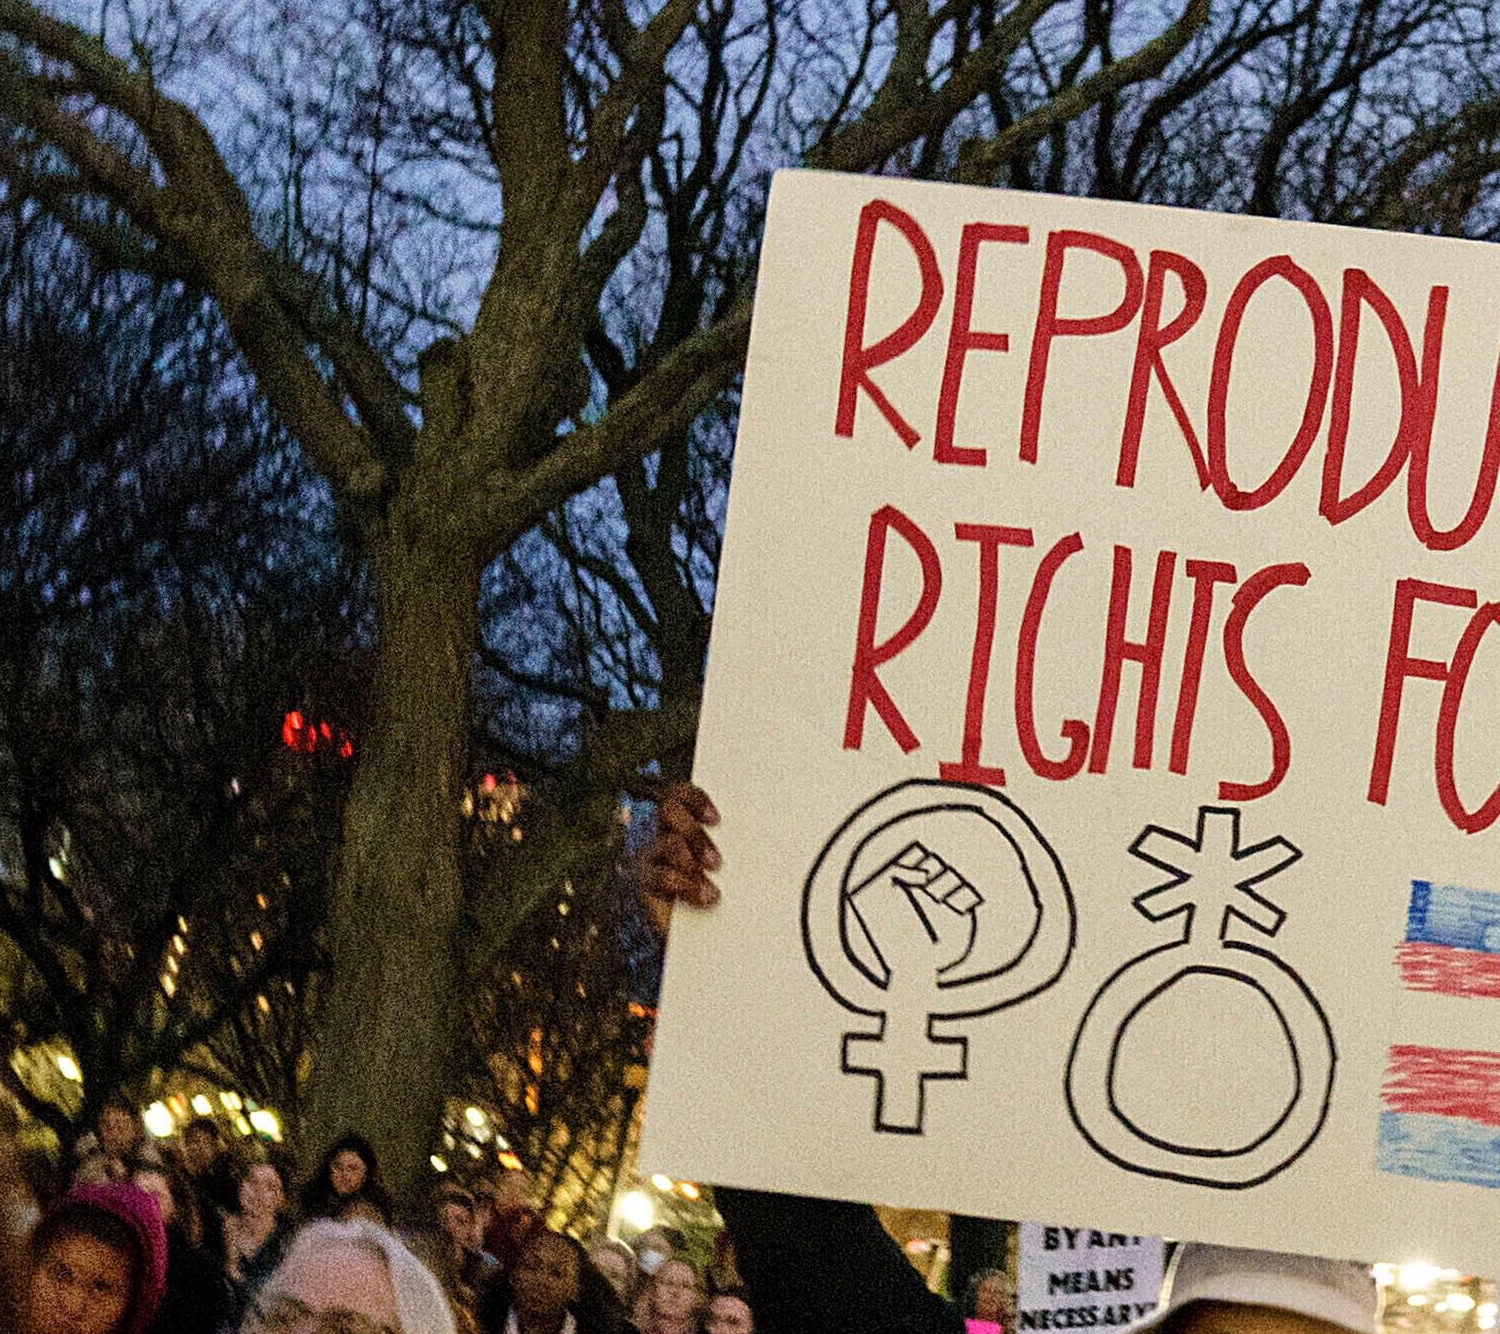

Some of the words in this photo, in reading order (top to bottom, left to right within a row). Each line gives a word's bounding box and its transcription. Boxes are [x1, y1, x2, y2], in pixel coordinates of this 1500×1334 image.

[843, 505, 1311, 801] RIGHTS
[1043, 1226, 1079, 1251] BY
[1049, 1267, 1135, 1296] MEANS
